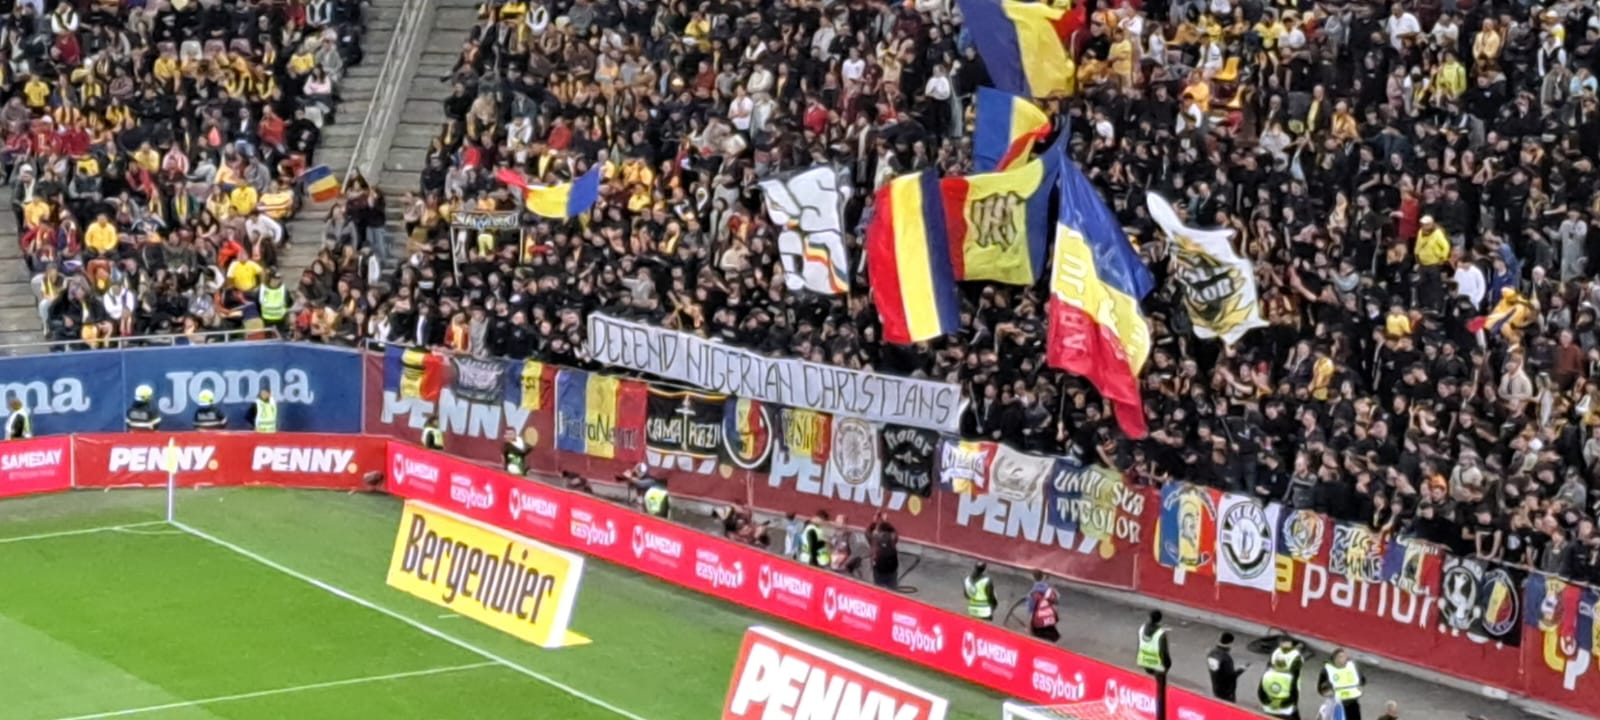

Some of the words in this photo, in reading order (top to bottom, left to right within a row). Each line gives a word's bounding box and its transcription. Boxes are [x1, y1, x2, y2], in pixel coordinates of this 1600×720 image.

[685, 336, 794, 404] NIGERIAN
[803, 364, 953, 424] CHRISTIANS
[1, 449, 62, 469] SAMEDAY
[405, 457, 440, 483] SAMEDAY
[522, 492, 558, 519] SAMEDAY
[645, 532, 682, 559] SAMEDAY
[400, 513, 555, 624] Bergenbier
[772, 572, 813, 599] SAMEDAY
[837, 593, 879, 620] SAMEDAY
[976, 637, 1018, 668] SAMEDAY
[1119, 682, 1158, 716] SAMEDA
